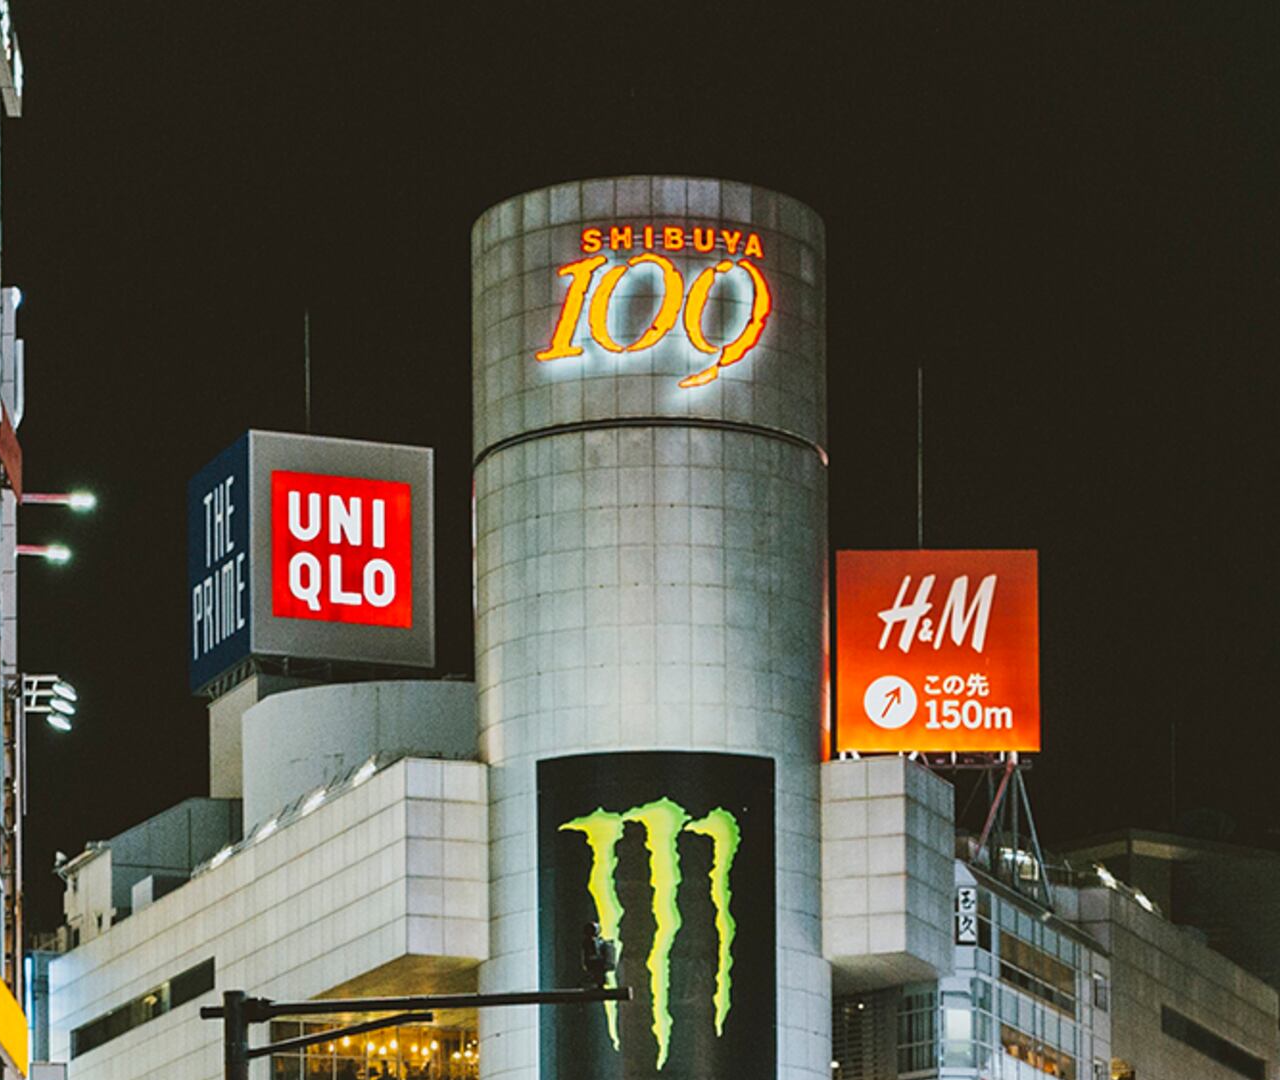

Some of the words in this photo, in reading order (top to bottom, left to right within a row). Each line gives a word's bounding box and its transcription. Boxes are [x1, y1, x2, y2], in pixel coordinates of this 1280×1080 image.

[581, 225, 764, 258] SHIBUYA
[535, 253, 772, 388] 109
[203, 475, 234, 569] THE
[288, 490, 386, 549] UNI
[193, 552, 246, 660] PRIME
[288, 552, 396, 611] QLO
[877, 574, 998, 653] H&M
[923, 673, 990, 697] この先
[924, 699, 1014, 730] 150m
